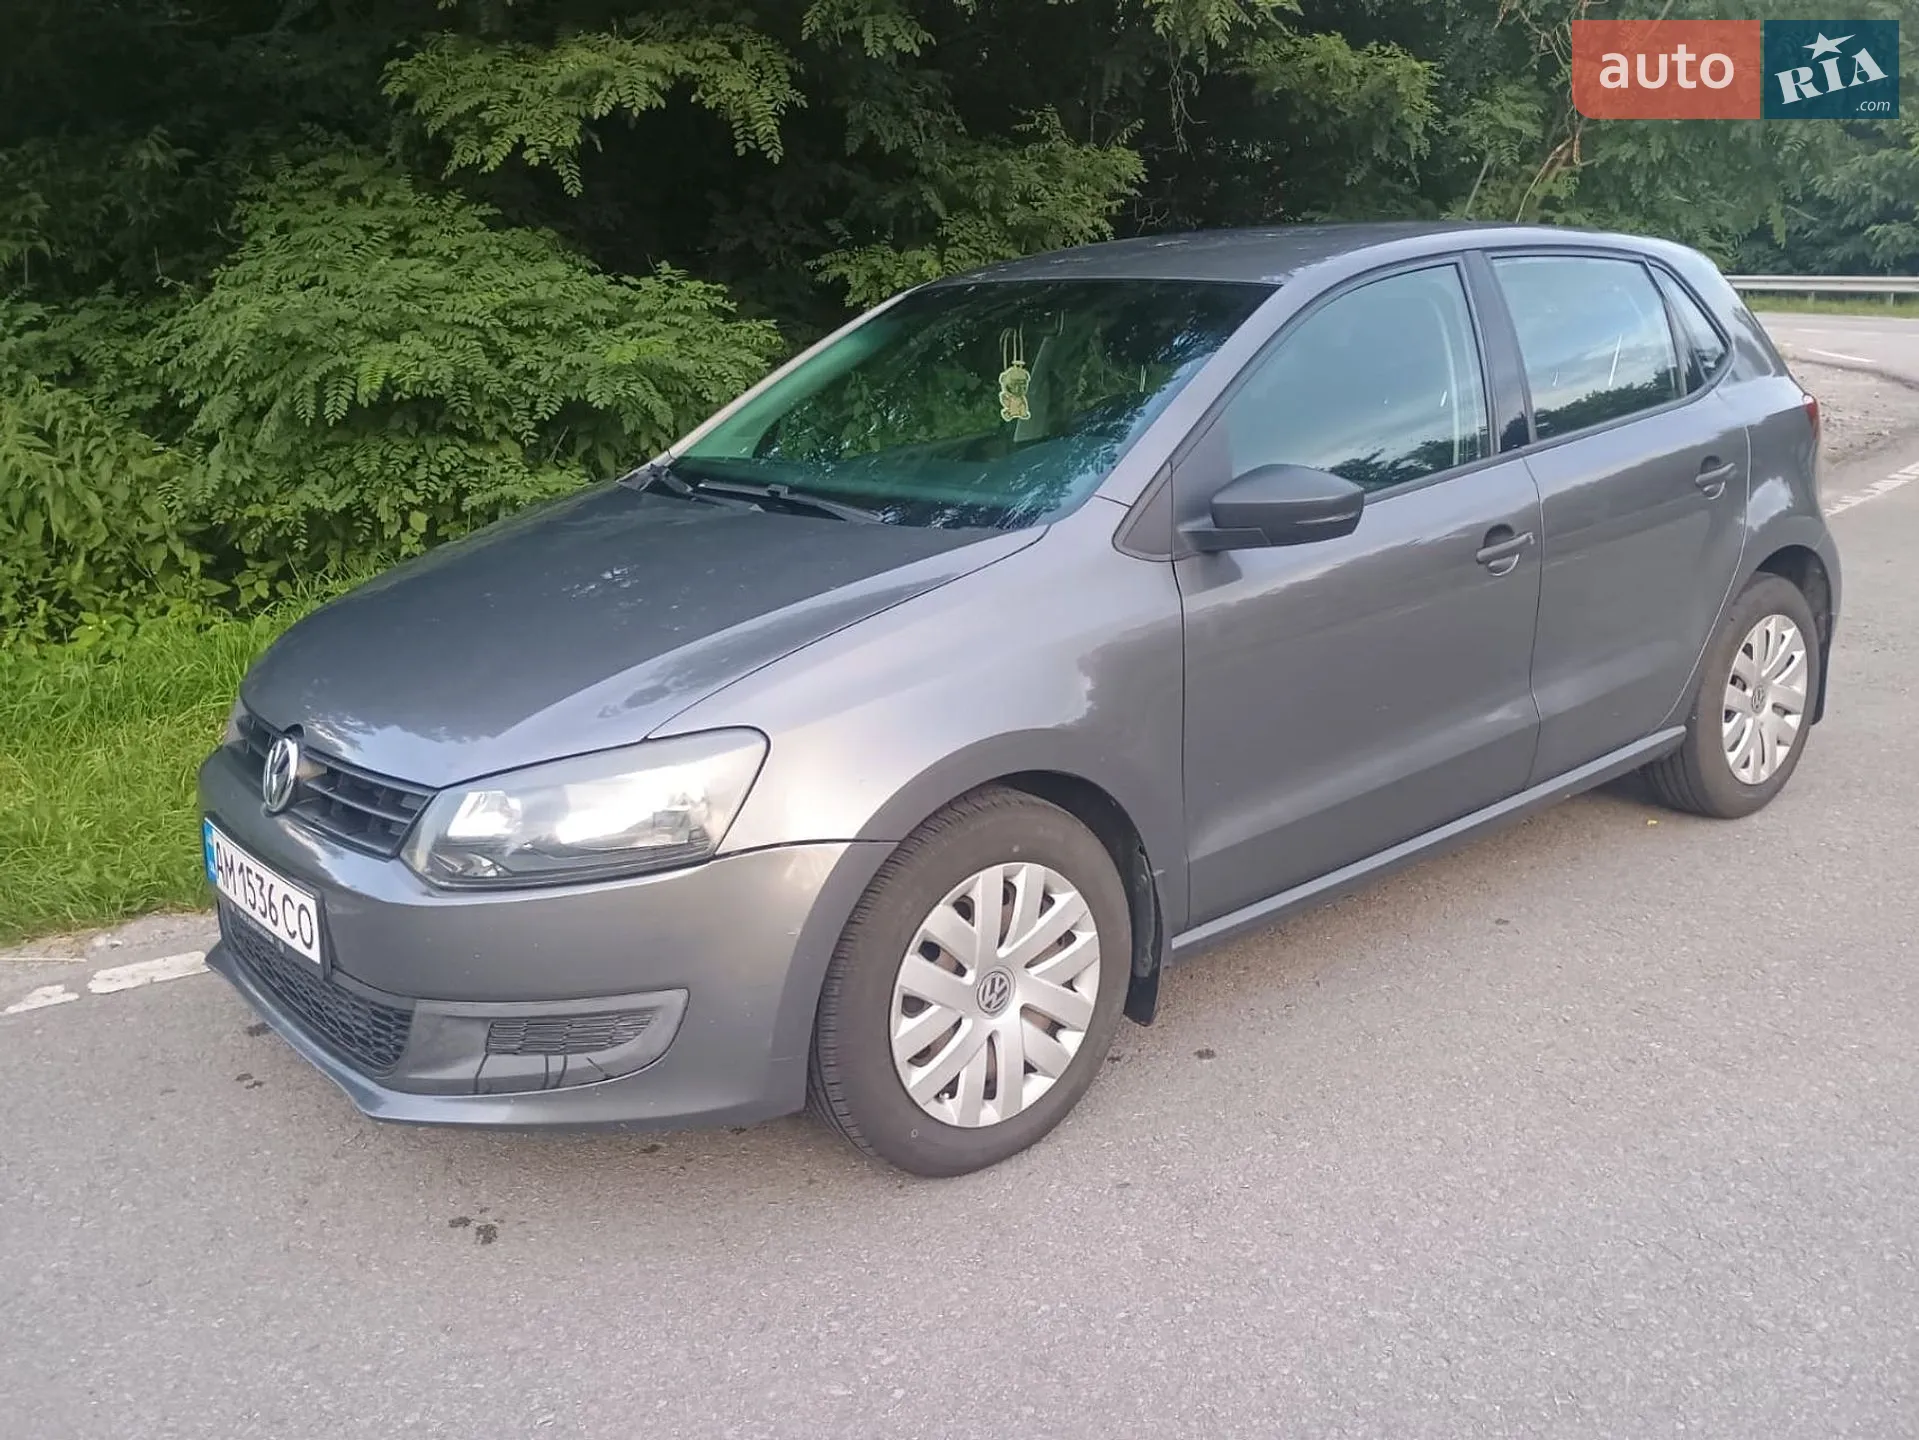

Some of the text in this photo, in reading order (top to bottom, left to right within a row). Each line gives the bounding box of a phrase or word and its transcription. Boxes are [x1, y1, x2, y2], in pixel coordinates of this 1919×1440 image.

[216, 841, 237, 896] AM
[238, 861, 279, 927] 1536
[282, 893, 314, 951] CO
